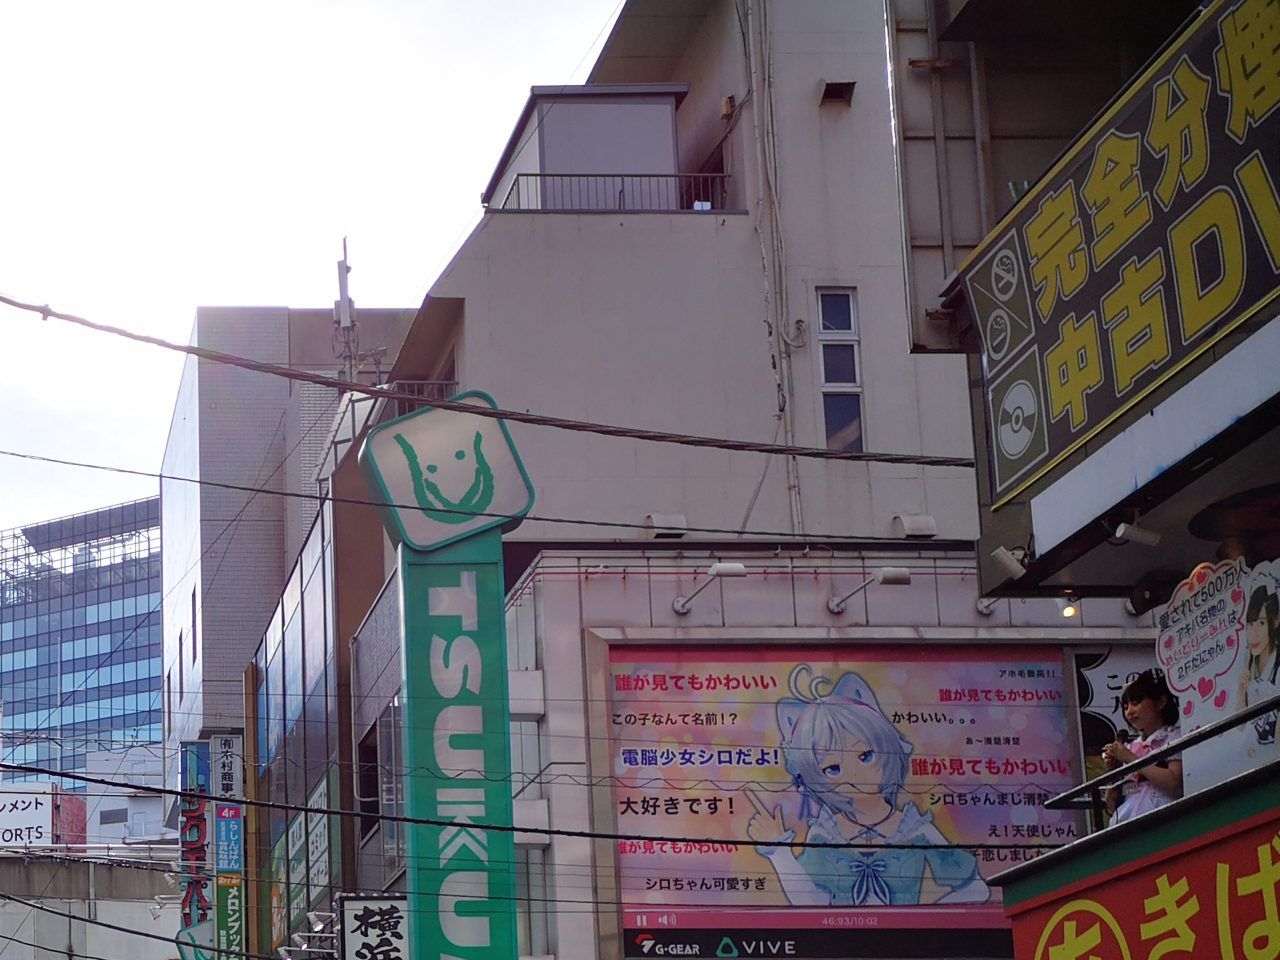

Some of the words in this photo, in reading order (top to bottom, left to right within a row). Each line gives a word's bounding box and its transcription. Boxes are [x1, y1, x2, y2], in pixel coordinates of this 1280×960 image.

[615, 674, 778, 692] 誰が見てもかわいい
[939, 688, 1062, 702] 誰が見てもかわいい
[911, 758, 1071, 776] 誰が見てもかわいい
[221, 807, 235, 818] 4F
[228, 820, 240, 869] らしんばん
[645, 877, 767, 891] シロちゃん可愛すぎ
[742, 940, 796, 955] VIVE
